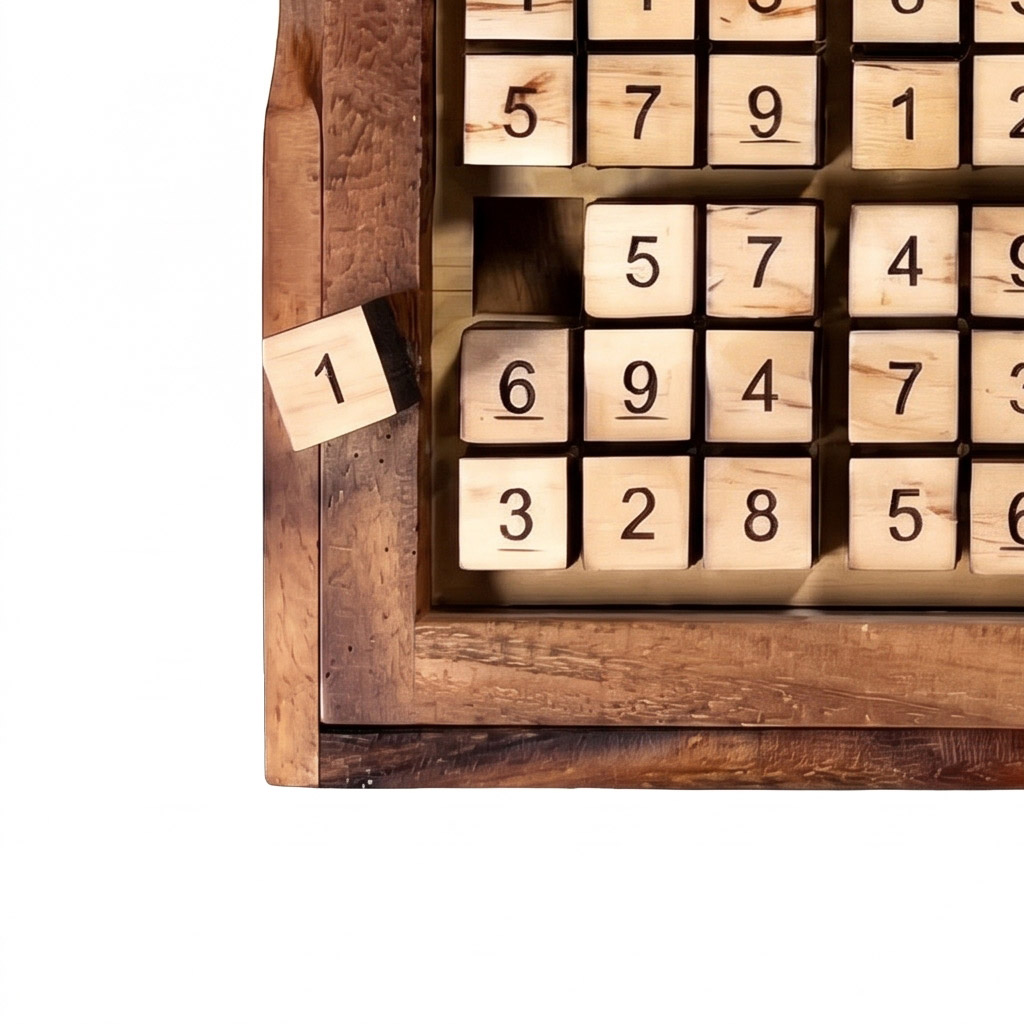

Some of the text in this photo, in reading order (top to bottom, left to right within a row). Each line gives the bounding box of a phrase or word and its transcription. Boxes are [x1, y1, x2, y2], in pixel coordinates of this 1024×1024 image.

[503, 86, 538, 138] 5
[626, 85, 661, 139] 7
[749, 86, 782, 138] 9
[892, 87, 913, 140] 1
[627, 236, 659, 287] 5
[748, 236, 782, 288] 7
[888, 236, 922, 286] 4
[315, 353, 344, 404] 1
[499, 360, 535, 414] 6
[624, 361, 657, 414] 9
[742, 359, 778, 411] 4
[889, 361, 922, 415] 7
[500, 488, 532, 540] 3
[621, 488, 655, 539] 2
[744, 489, 778, 542] 8
[889, 489, 922, 541] 5
